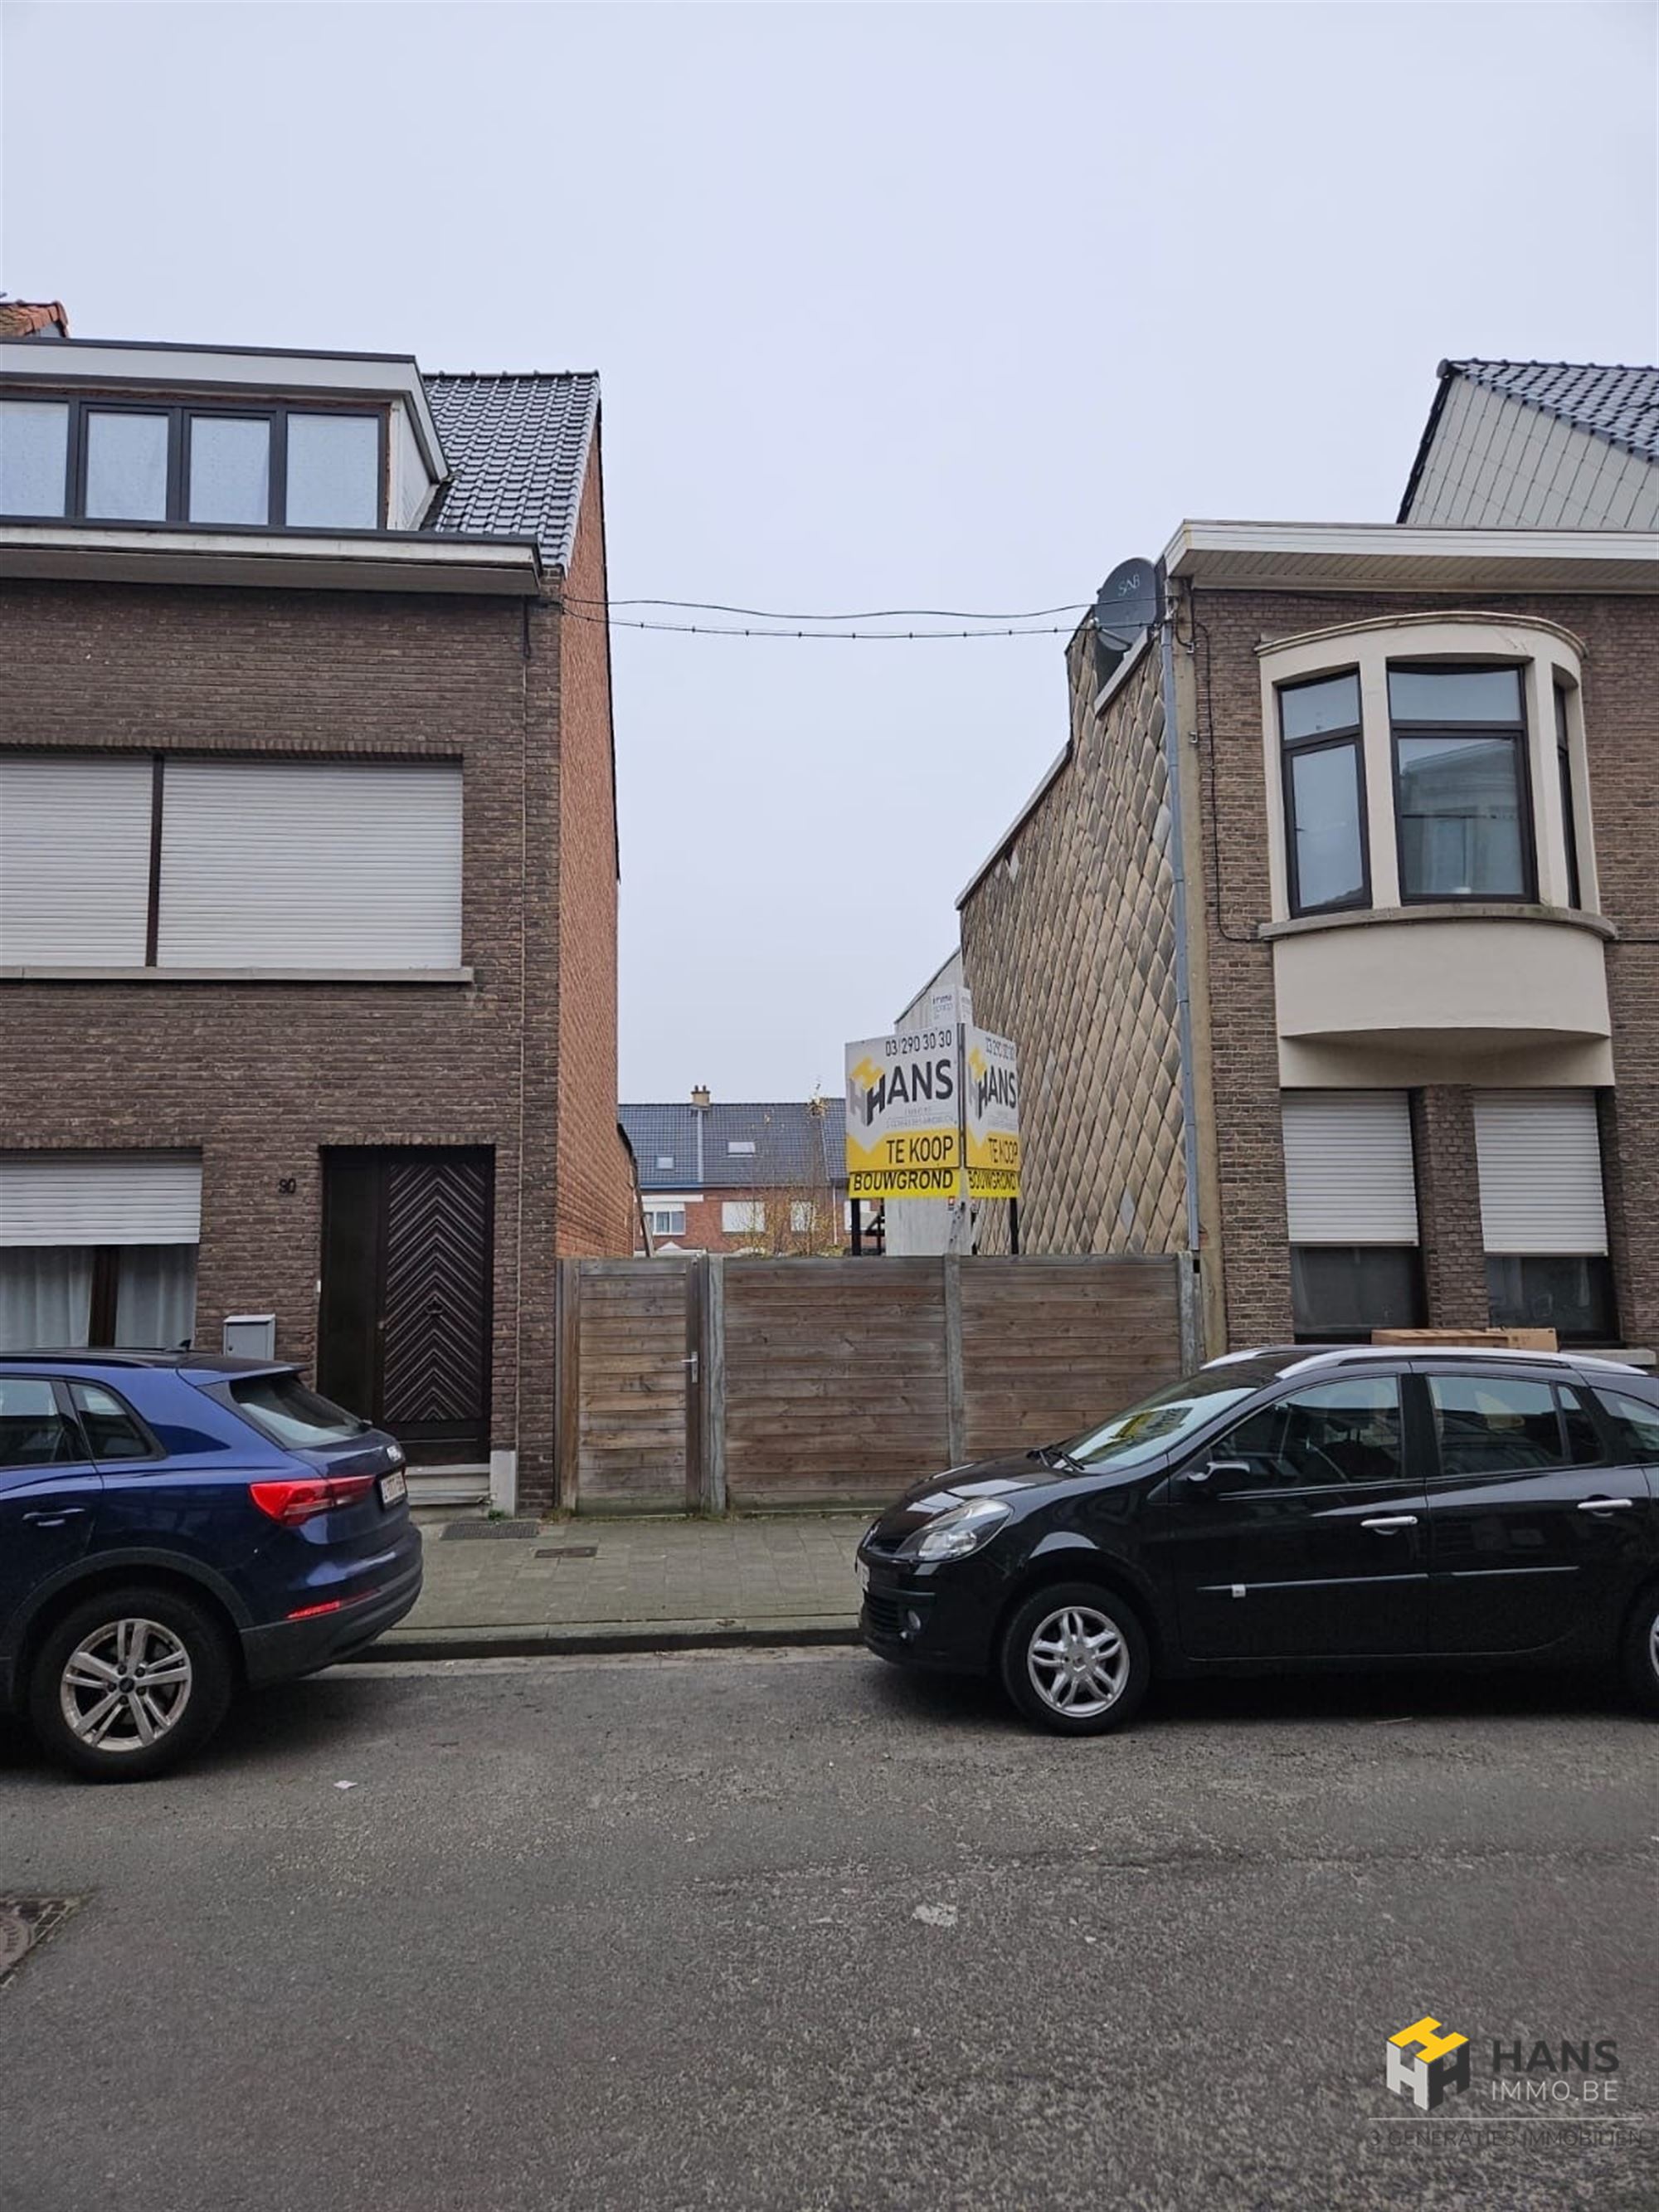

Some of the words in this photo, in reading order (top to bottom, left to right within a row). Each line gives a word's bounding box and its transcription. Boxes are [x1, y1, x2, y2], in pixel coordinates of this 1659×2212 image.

[922, 1032, 937, 1050] 30
[938, 1029, 952, 1048] 30
[867, 1059, 954, 1127] HANS
[886, 1139, 905, 1164] TE
[909, 1135, 953, 1162] KOOP
[854, 1169, 953, 1191] BOUWGROND
